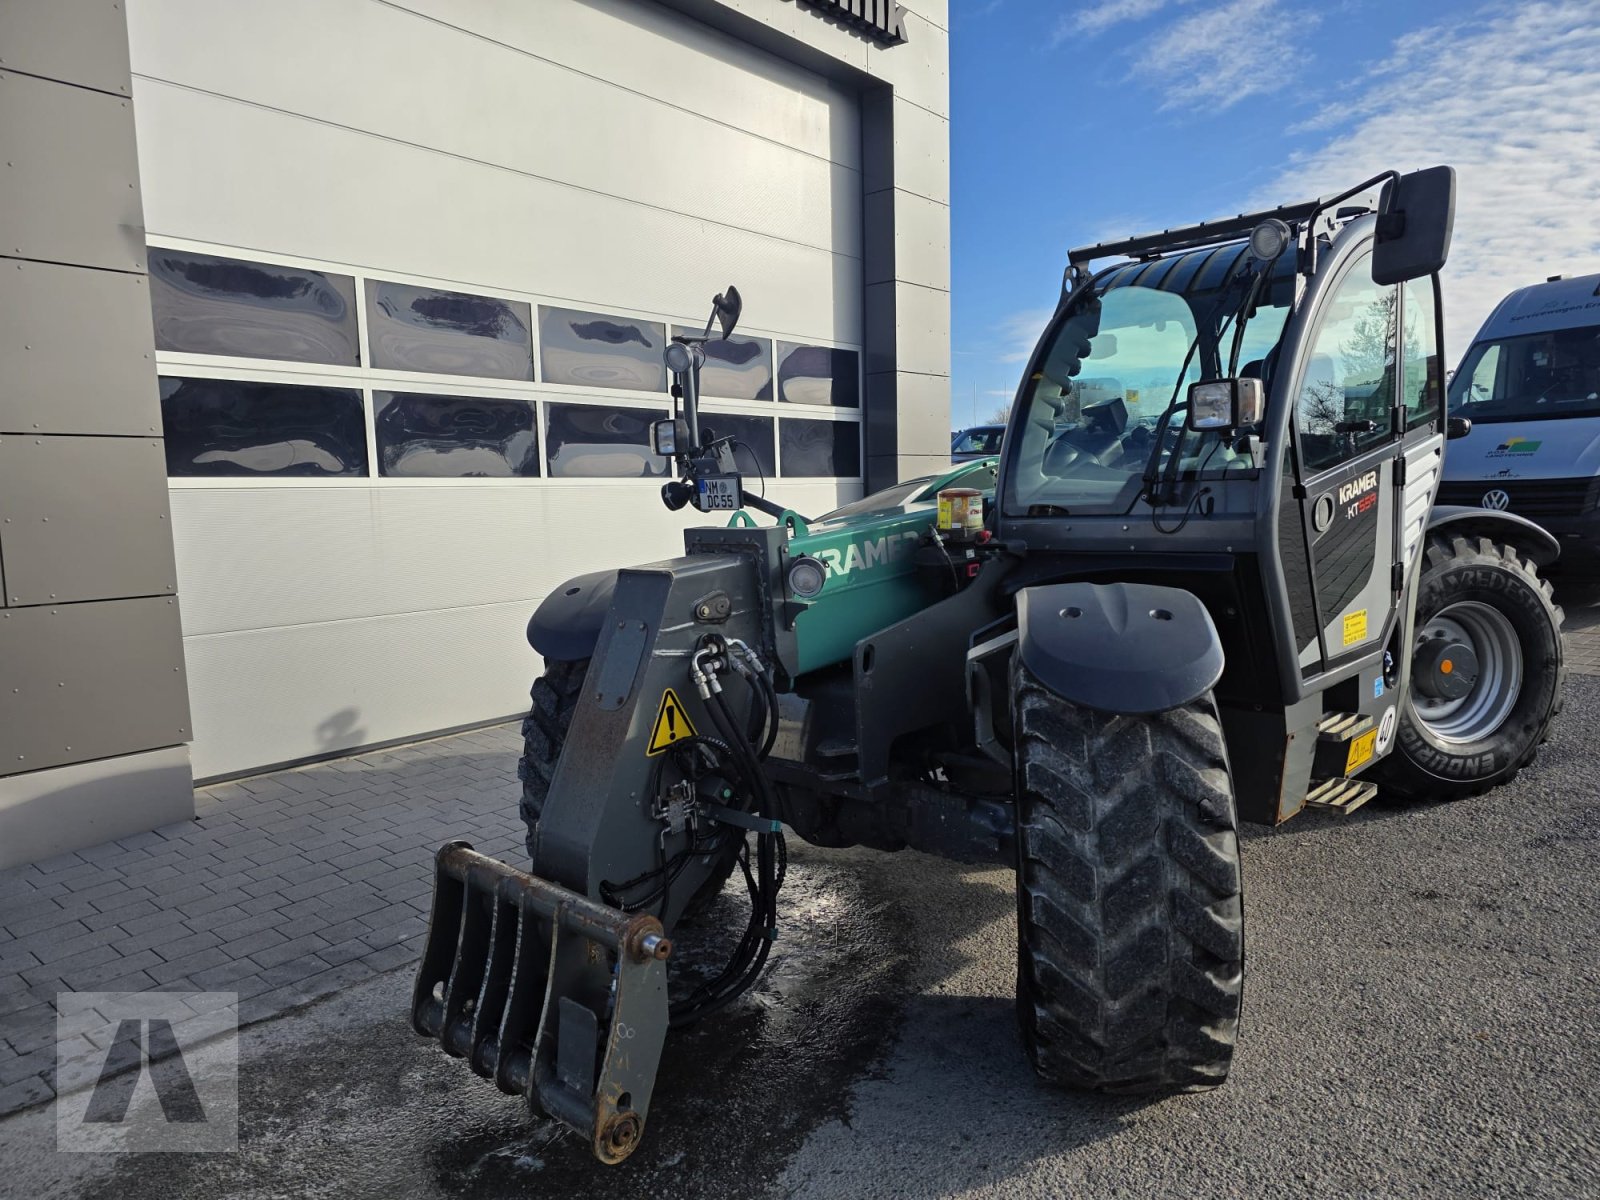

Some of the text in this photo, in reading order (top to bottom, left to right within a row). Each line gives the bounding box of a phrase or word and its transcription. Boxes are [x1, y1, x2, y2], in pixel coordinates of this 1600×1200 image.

[705, 481, 718, 494] NM
[1339, 470, 1377, 505] KRAMER
[1379, 713, 1393, 743] 40
